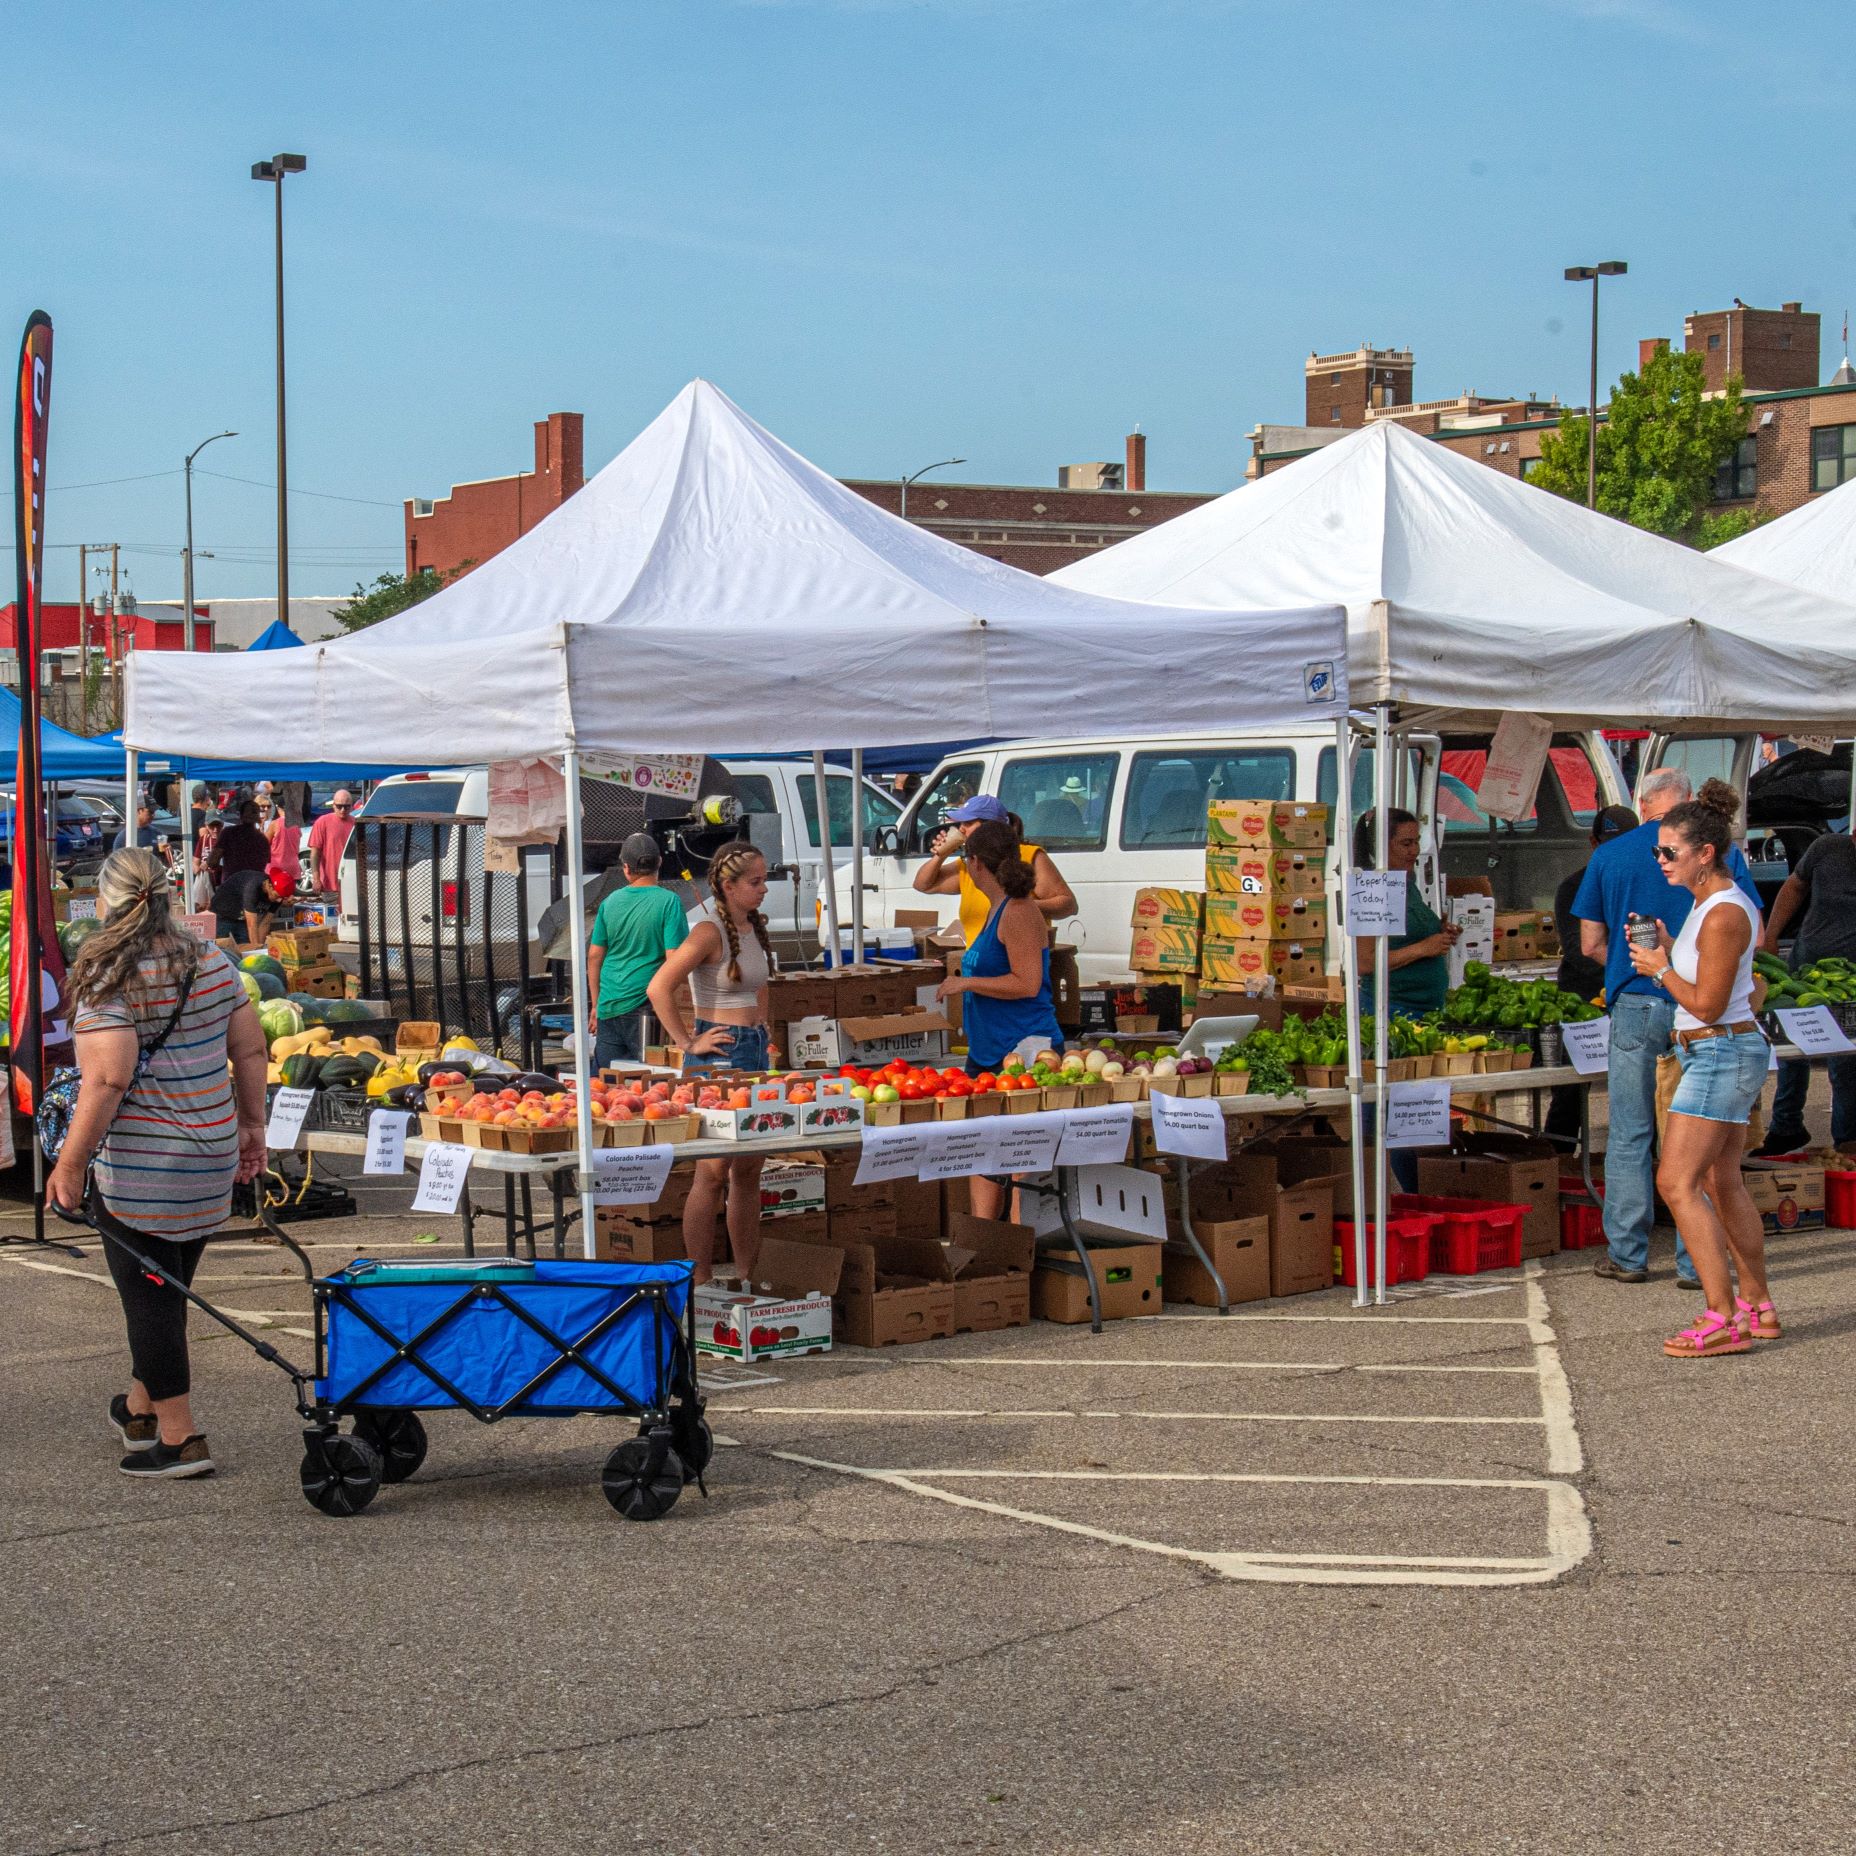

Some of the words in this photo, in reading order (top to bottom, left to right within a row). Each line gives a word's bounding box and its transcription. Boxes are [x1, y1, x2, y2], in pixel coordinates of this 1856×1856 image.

[1242, 877, 1253, 892] G
[1355, 873, 1381, 888] Pepper
[1467, 915, 1485, 925] Fuller
[884, 1035, 923, 1051] Fuller
[807, 1043, 829, 1056] Fuller
[1193, 1111, 1215, 1119] Onions
[1069, 1119, 1102, 1128] Homegrown
[1180, 1122, 1197, 1130] quart
[882, 1136, 917, 1145] Homegrown
[946, 1132, 981, 1141] Homegrown
[429, 1149, 454, 1166] Colorado
[605, 1155, 634, 1163] Colorado
[635, 1153, 661, 1161] Palisade
[874, 1150, 892, 1158] Green
[958, 1153, 974, 1161] quart
[888, 1158, 903, 1166] quart
[775, 1172, 794, 1180] FRESH
[794, 1169, 823, 1178] PRODUCE
[703, 1309, 732, 1320] PRODUCE
[750, 1308, 771, 1318] FARM
[772, 1305, 796, 1315] FRESH
[796, 1301, 832, 1312] PRODUCE
